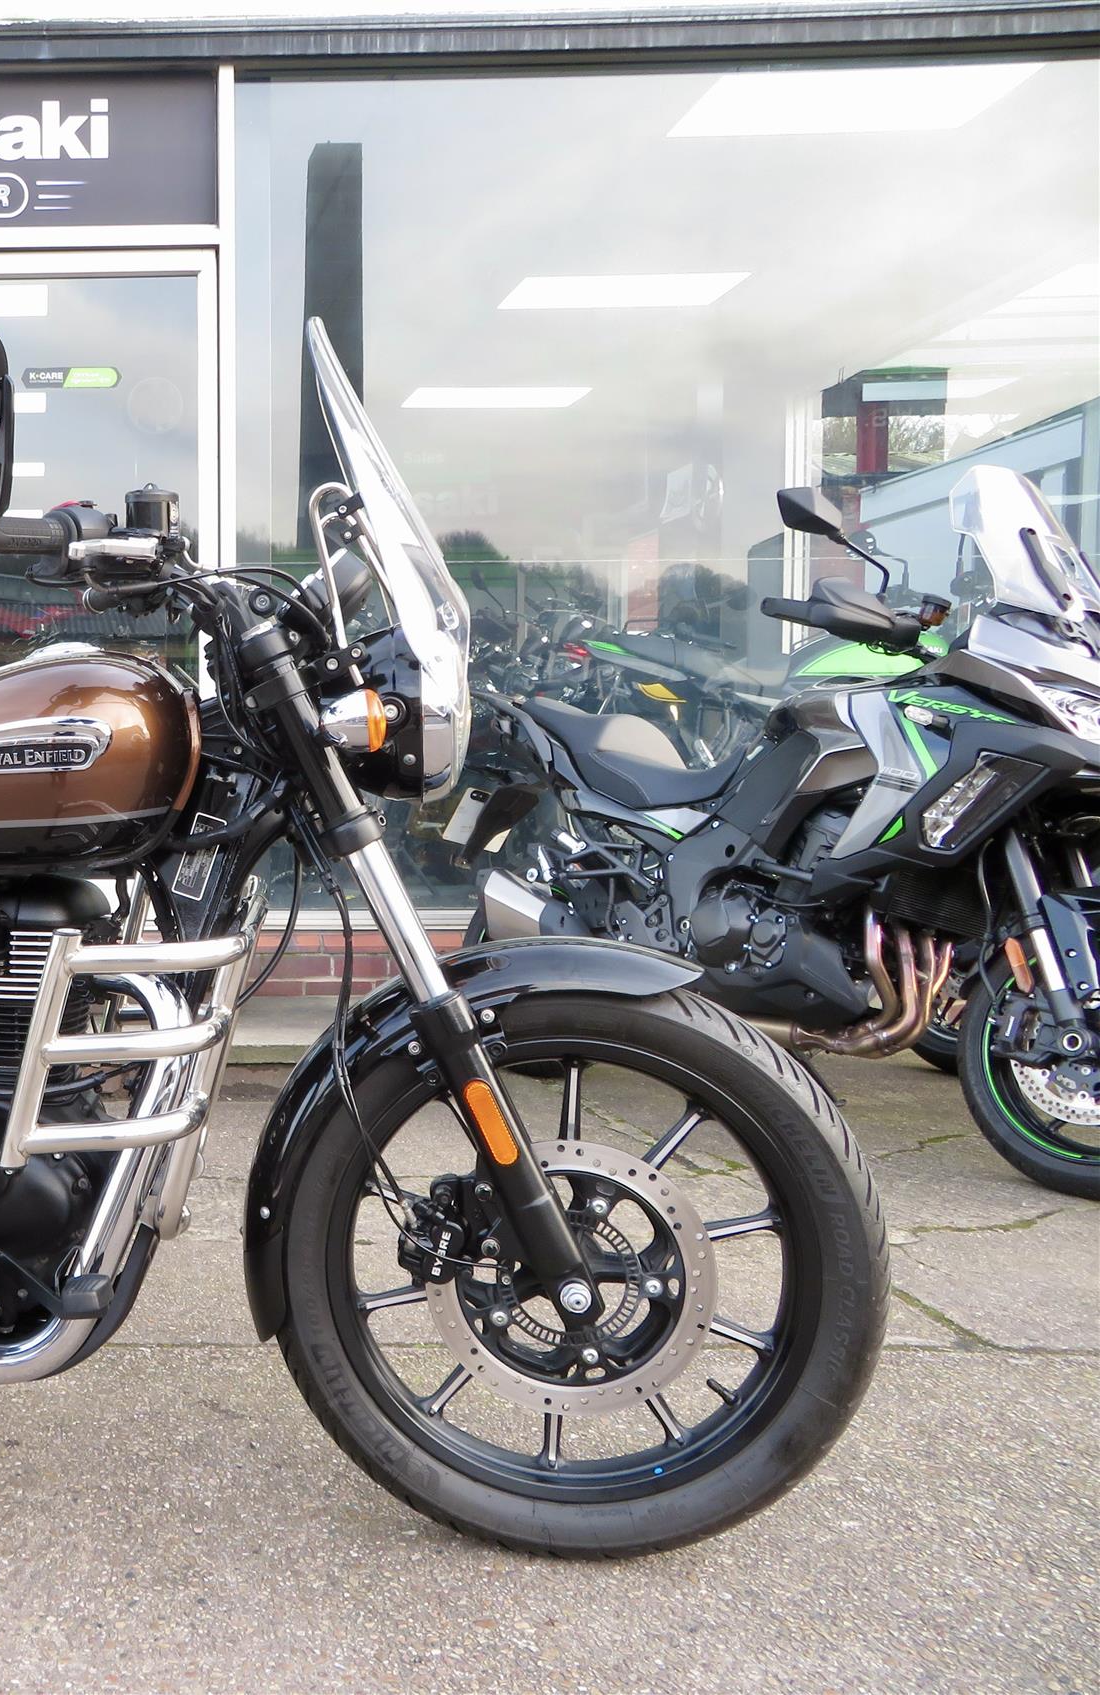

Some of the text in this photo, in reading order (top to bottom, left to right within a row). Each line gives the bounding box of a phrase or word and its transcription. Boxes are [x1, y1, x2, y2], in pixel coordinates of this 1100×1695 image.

[23, 748, 87, 766] ENFIELD
[430, 1230, 452, 1278] BYBRE
[827, 1210, 857, 1278] ROAD
